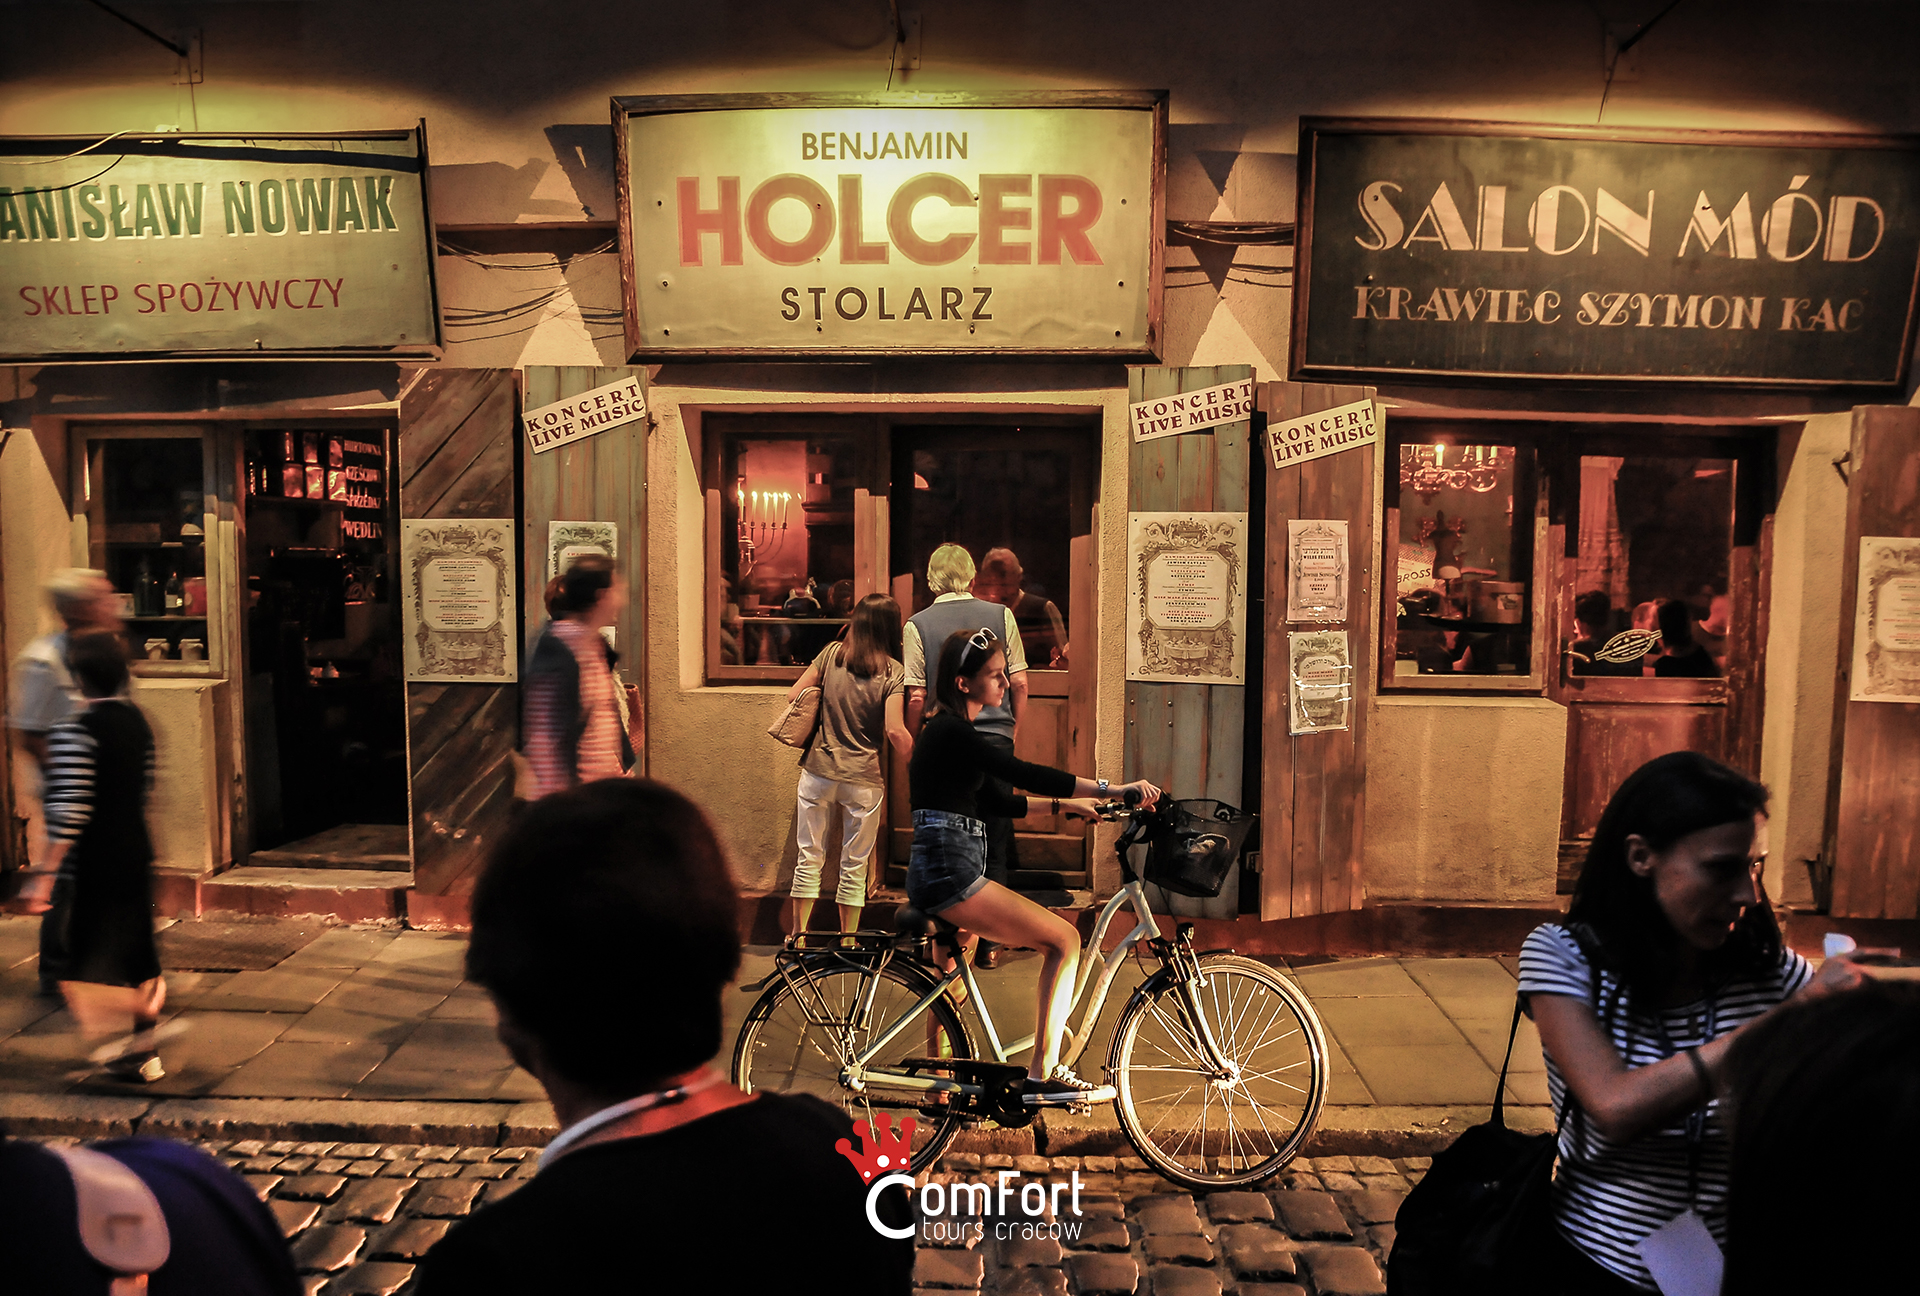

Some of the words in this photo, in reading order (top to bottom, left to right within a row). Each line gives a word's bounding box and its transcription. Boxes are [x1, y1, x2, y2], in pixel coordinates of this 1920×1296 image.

[801, 131, 969, 161] BENJAMIN
[0, 180, 206, 243] ANISŁAW
[222, 175, 399, 237] NOWAK
[676, 172, 1104, 267] HOLCER
[1354, 180, 1656, 257] SALON
[1677, 175, 1885, 263] MÓD
[19, 284, 119, 317] SKLEP
[134, 276, 345, 315] SPOŻYWCZY
[780, 286, 994, 322] STOLARZ
[1353, 285, 1562, 325] KRAWIEC
[1576, 290, 1765, 331] SZYMON
[526, 384, 638, 433] KONCERT
[1135, 382, 1251, 420] KONCERT
[531, 422, 576, 448] LIVE
[580, 399, 645, 431] MUSIC
[1138, 415, 1183, 436] LIVE
[1271, 407, 1372, 446] KONCERT
[1274, 438, 1315, 463] LIVE
[1320, 423, 1376, 450] MUSIC
